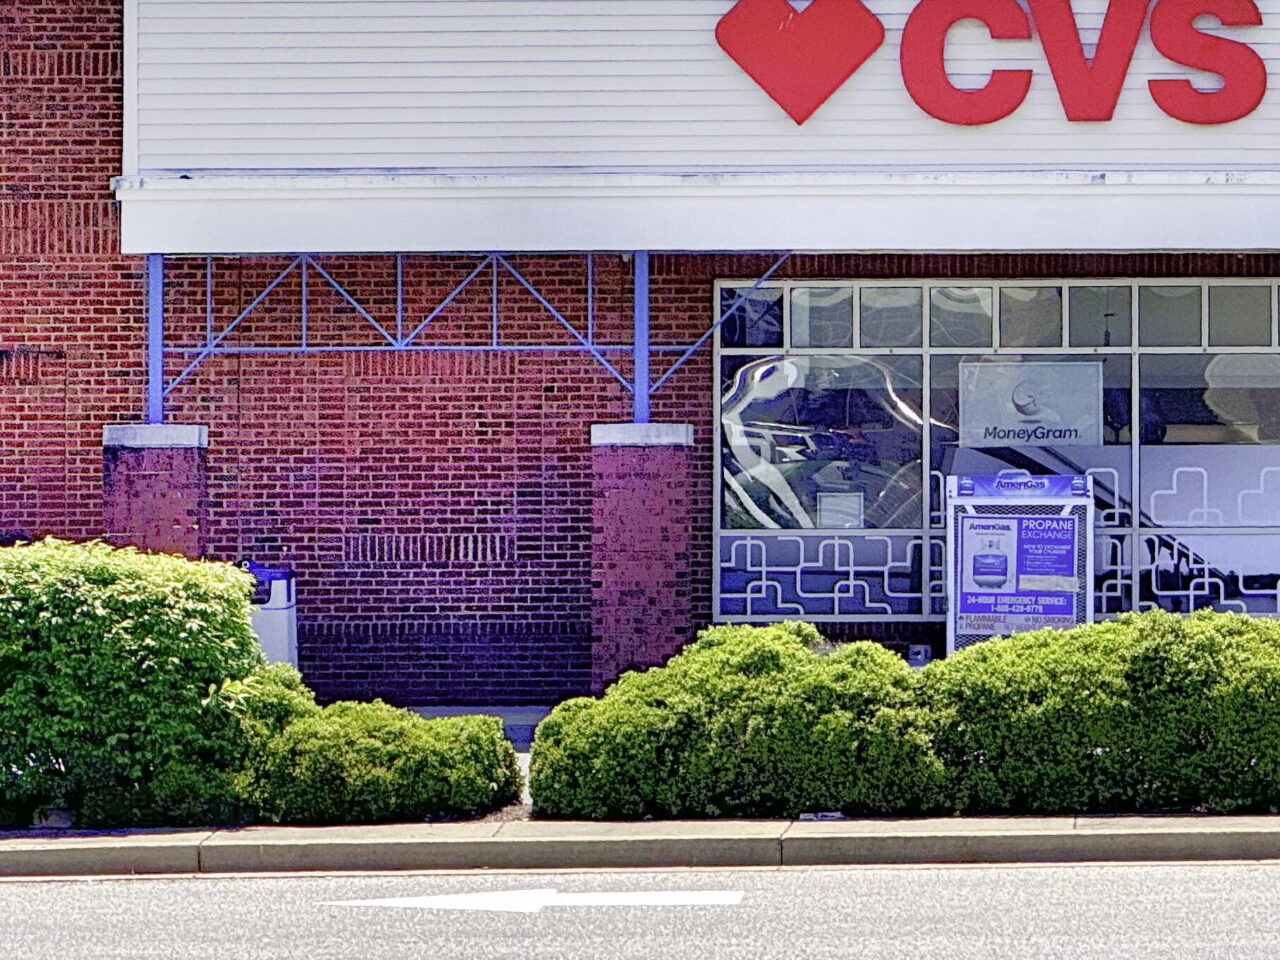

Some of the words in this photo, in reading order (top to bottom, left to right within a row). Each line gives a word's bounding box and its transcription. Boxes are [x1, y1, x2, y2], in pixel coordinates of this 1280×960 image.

[983, 426, 1079, 442] MoneyGram
[995, 480, 1046, 490] AmeriGas
[1022, 520, 1074, 530] PROPANE
[1021, 530, 1073, 540] EXCHANGE
[965, 615, 1008, 623] FLAMMABLE
[1031, 616, 1042, 624] NO
[1043, 616, 1075, 625] SMOKING
[965, 623, 996, 631] PROPANE
